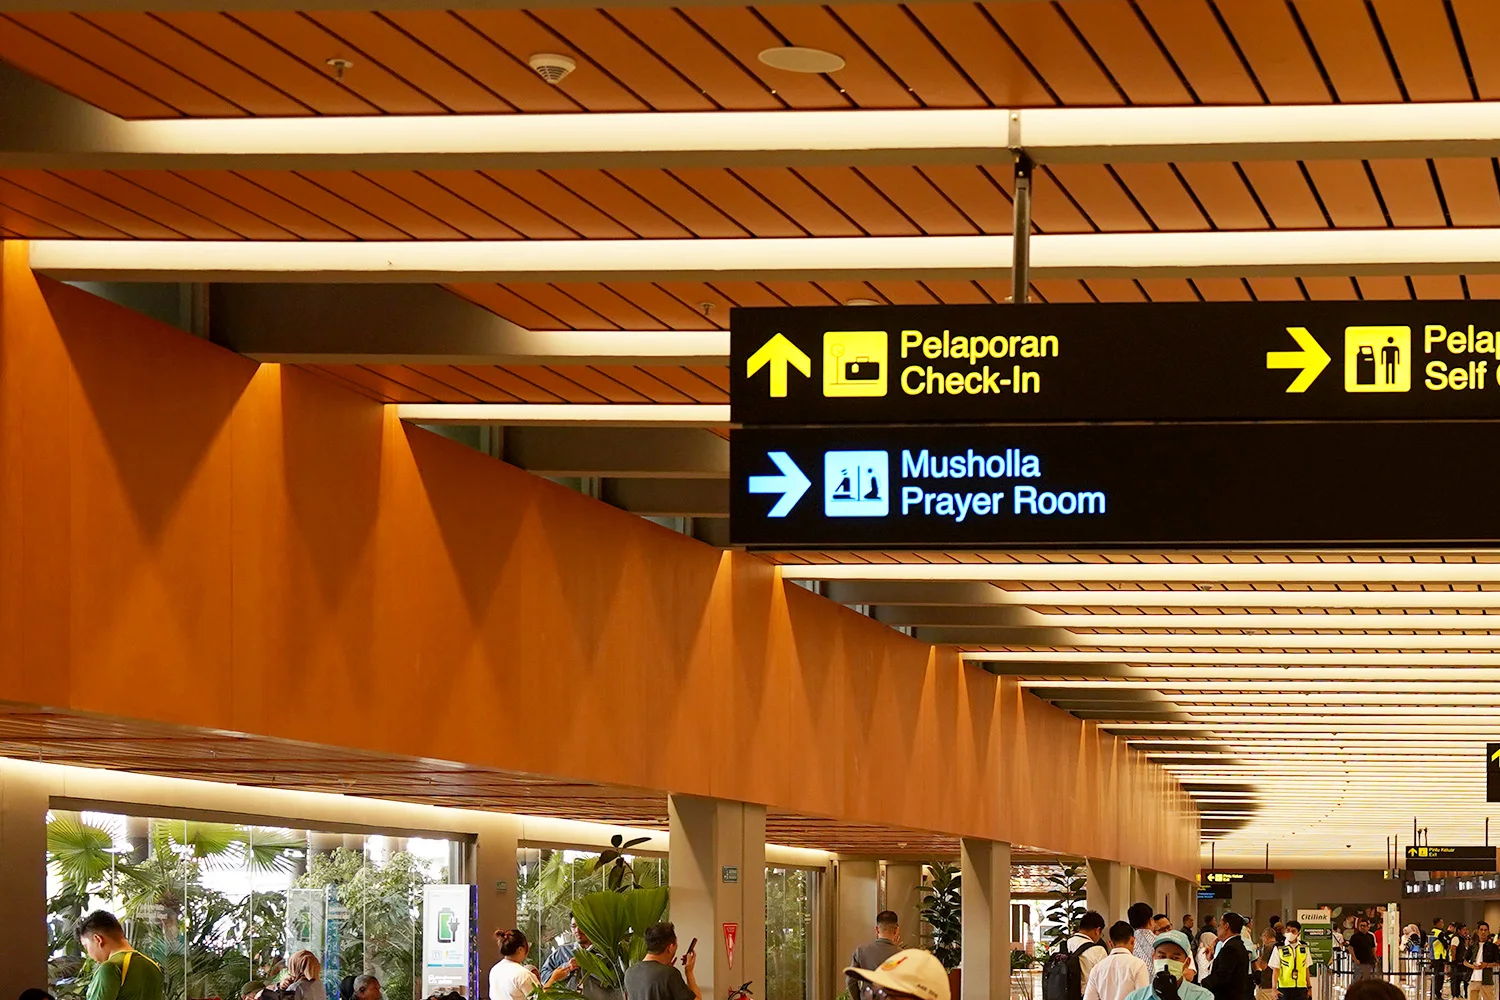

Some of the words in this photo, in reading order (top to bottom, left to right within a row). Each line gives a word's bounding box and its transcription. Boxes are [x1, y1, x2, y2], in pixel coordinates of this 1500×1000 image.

[900, 330, 1059, 365] Pelaporan
[900, 366, 1041, 395] Check-In
[1424, 361, 1488, 390] Self
[901, 449, 1042, 479] Musholla
[901, 486, 1005, 522] Prayer
[1013, 486, 1106, 515] Room
[1300, 913, 1328, 921] Citilink
